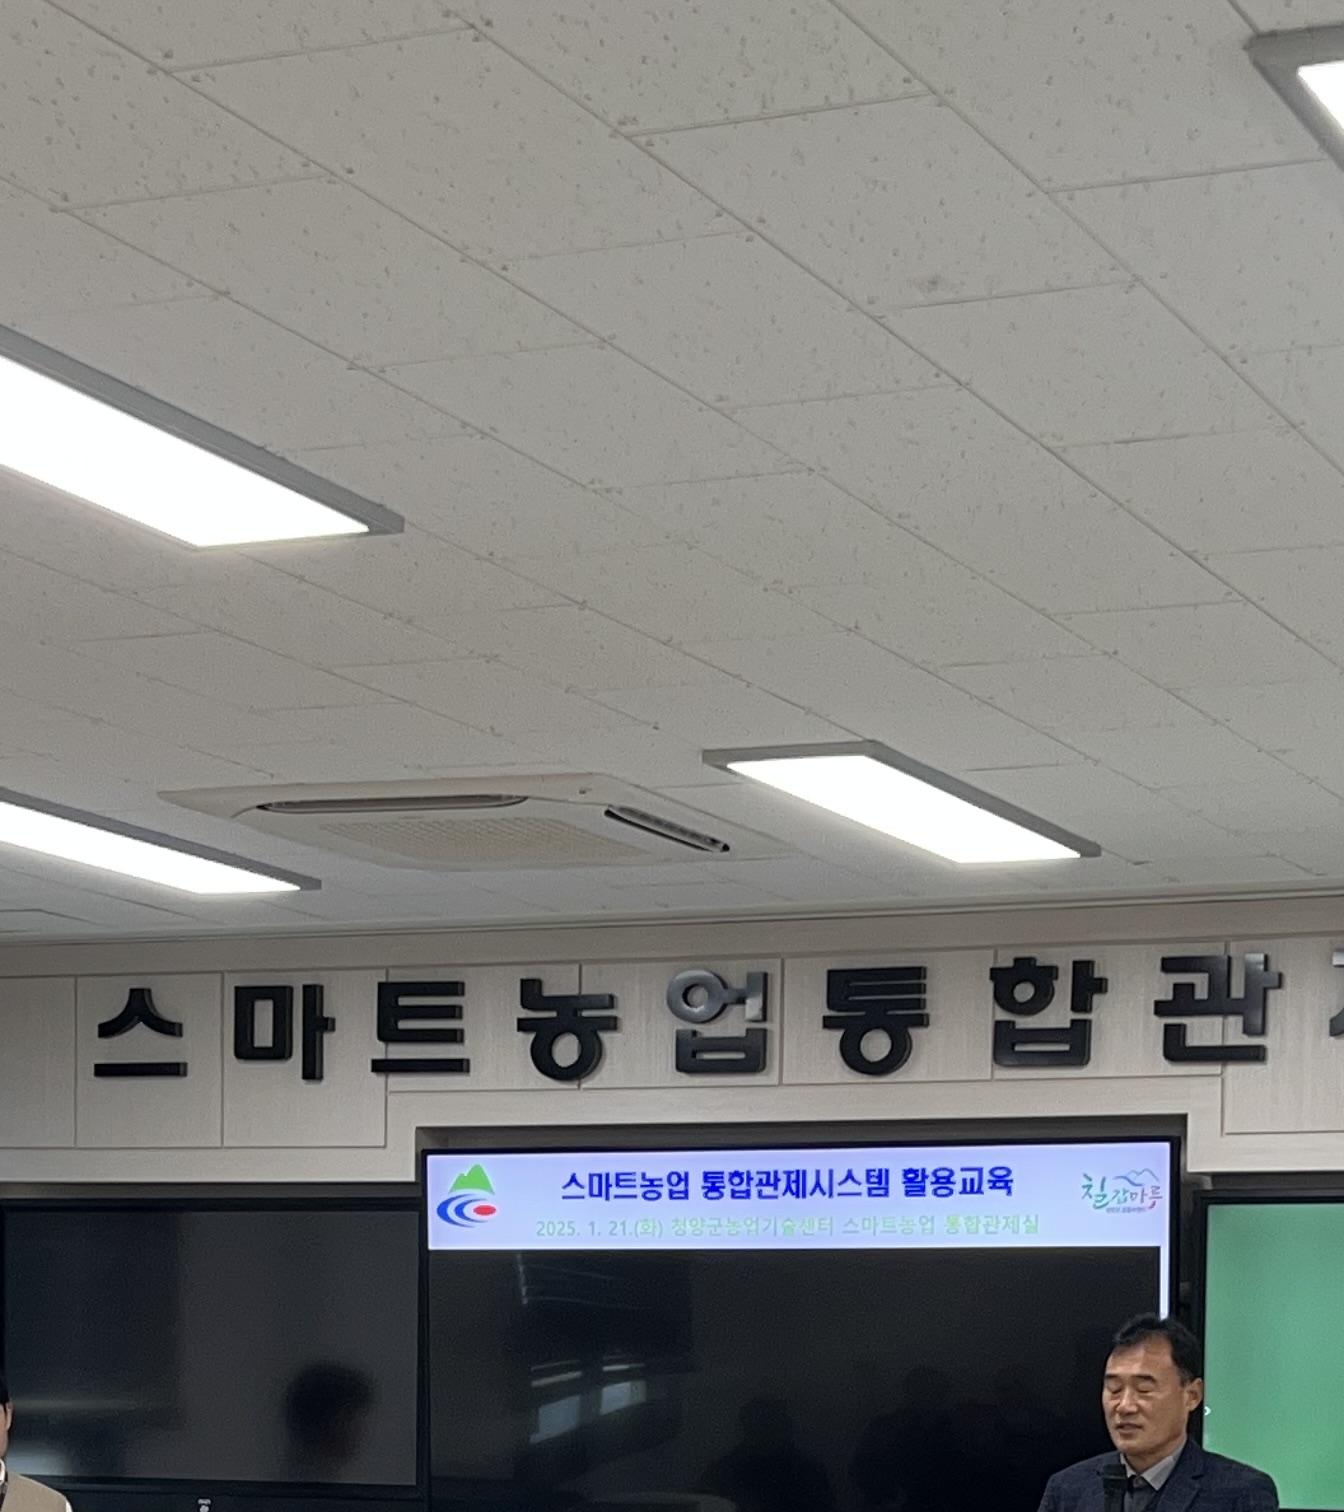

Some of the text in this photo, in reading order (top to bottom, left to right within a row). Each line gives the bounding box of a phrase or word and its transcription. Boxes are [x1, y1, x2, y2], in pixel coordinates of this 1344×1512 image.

[561, 1166, 1014, 1201] 스마트농업 통합관제시스템 활용교육
[535, 1214, 1040, 1239] 2025. 1. 21.(화) 청양군농업기술센터 스마트농업 통합관제실
